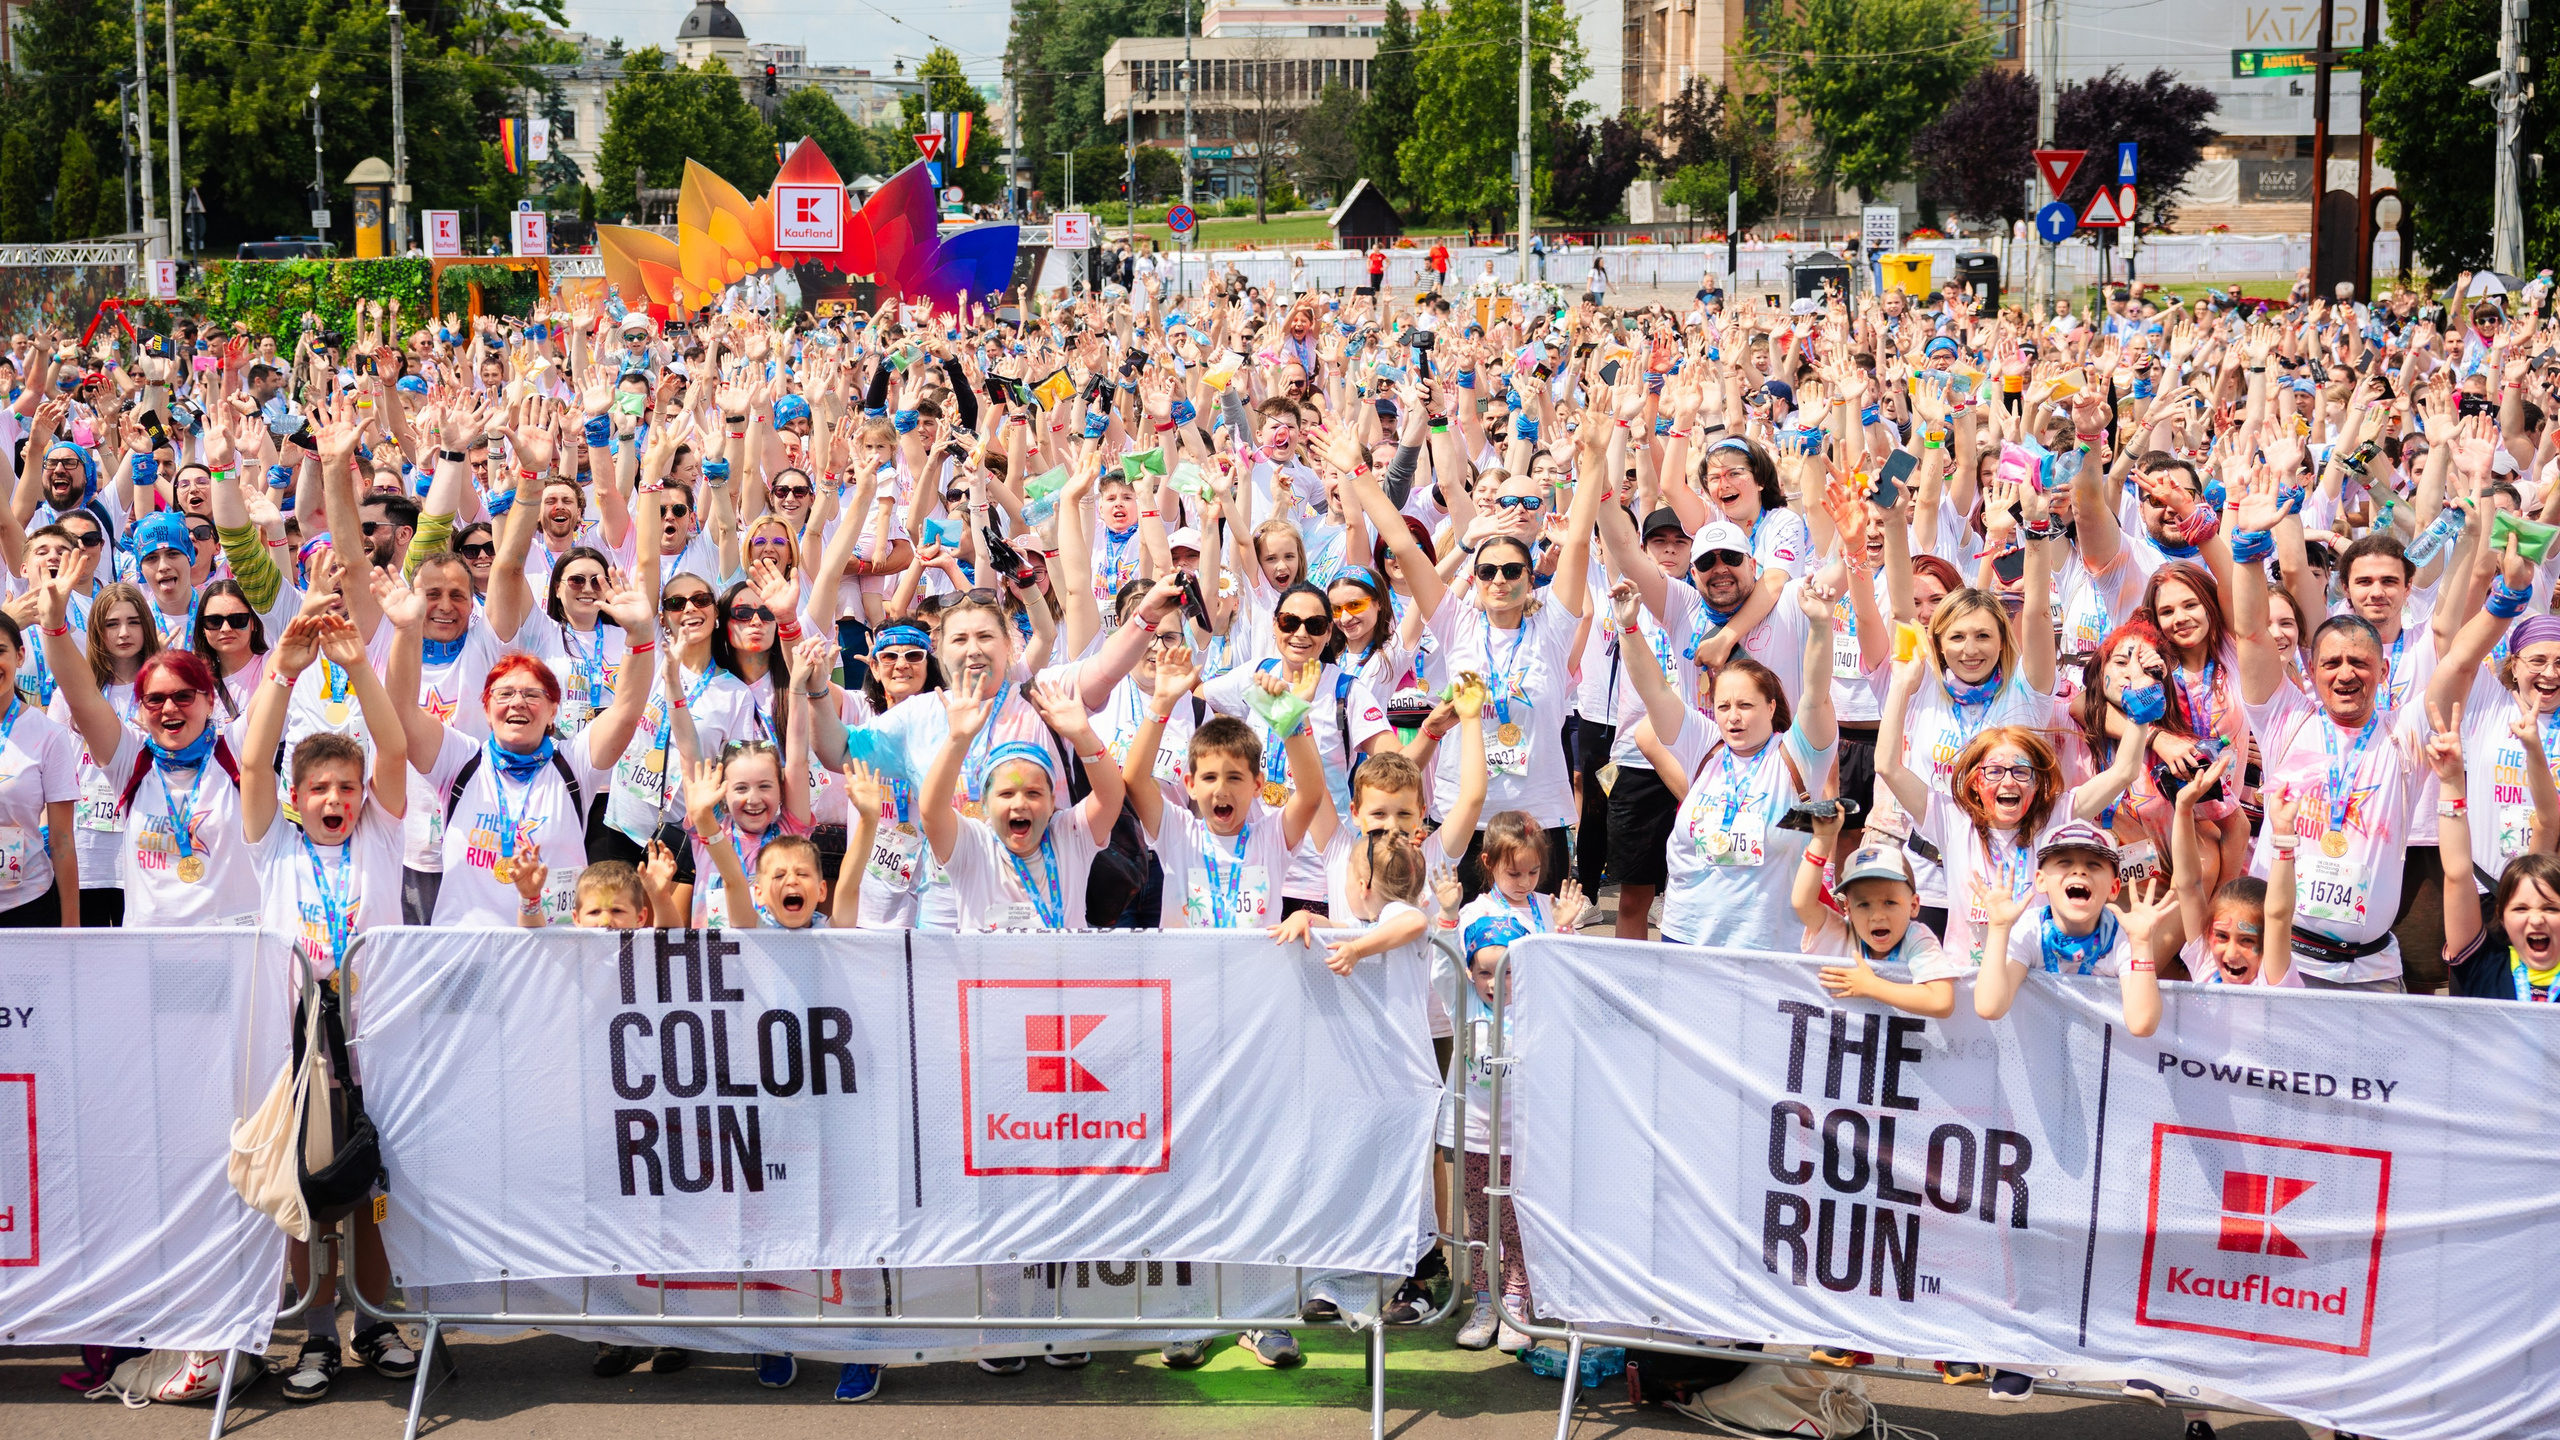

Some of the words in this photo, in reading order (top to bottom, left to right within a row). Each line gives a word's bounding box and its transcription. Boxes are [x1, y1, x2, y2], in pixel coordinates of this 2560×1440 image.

[784, 228, 833, 238] Kaufland
[2080, 612, 2098, 627] THE
[1834, 651, 1858, 668] 17401
[2140, 696, 2156, 708] RUN
[2498, 748, 2523, 768] THE
[2494, 785, 2523, 805] RUN
[143, 813, 171, 834] THE
[2296, 816, 2324, 842] RUN
[137, 850, 167, 870] RUN
[466, 846, 497, 870] RUN
[2310, 880, 2353, 907] 15734
[617, 930, 744, 1005] THE
[609, 1006, 857, 1100] COLOR
[1777, 999, 1927, 1111] THE
[2158, 1051, 2338, 1098] POWERED
[2352, 1075, 2399, 1104] BY
[986, 1112, 1148, 1141] Kaufland
[613, 1105, 764, 1196] RUN
[1767, 1100, 2033, 1229] COLOR
[1762, 1190, 1922, 1303] RUN
[2167, 1265, 2348, 1317] Kaufland
